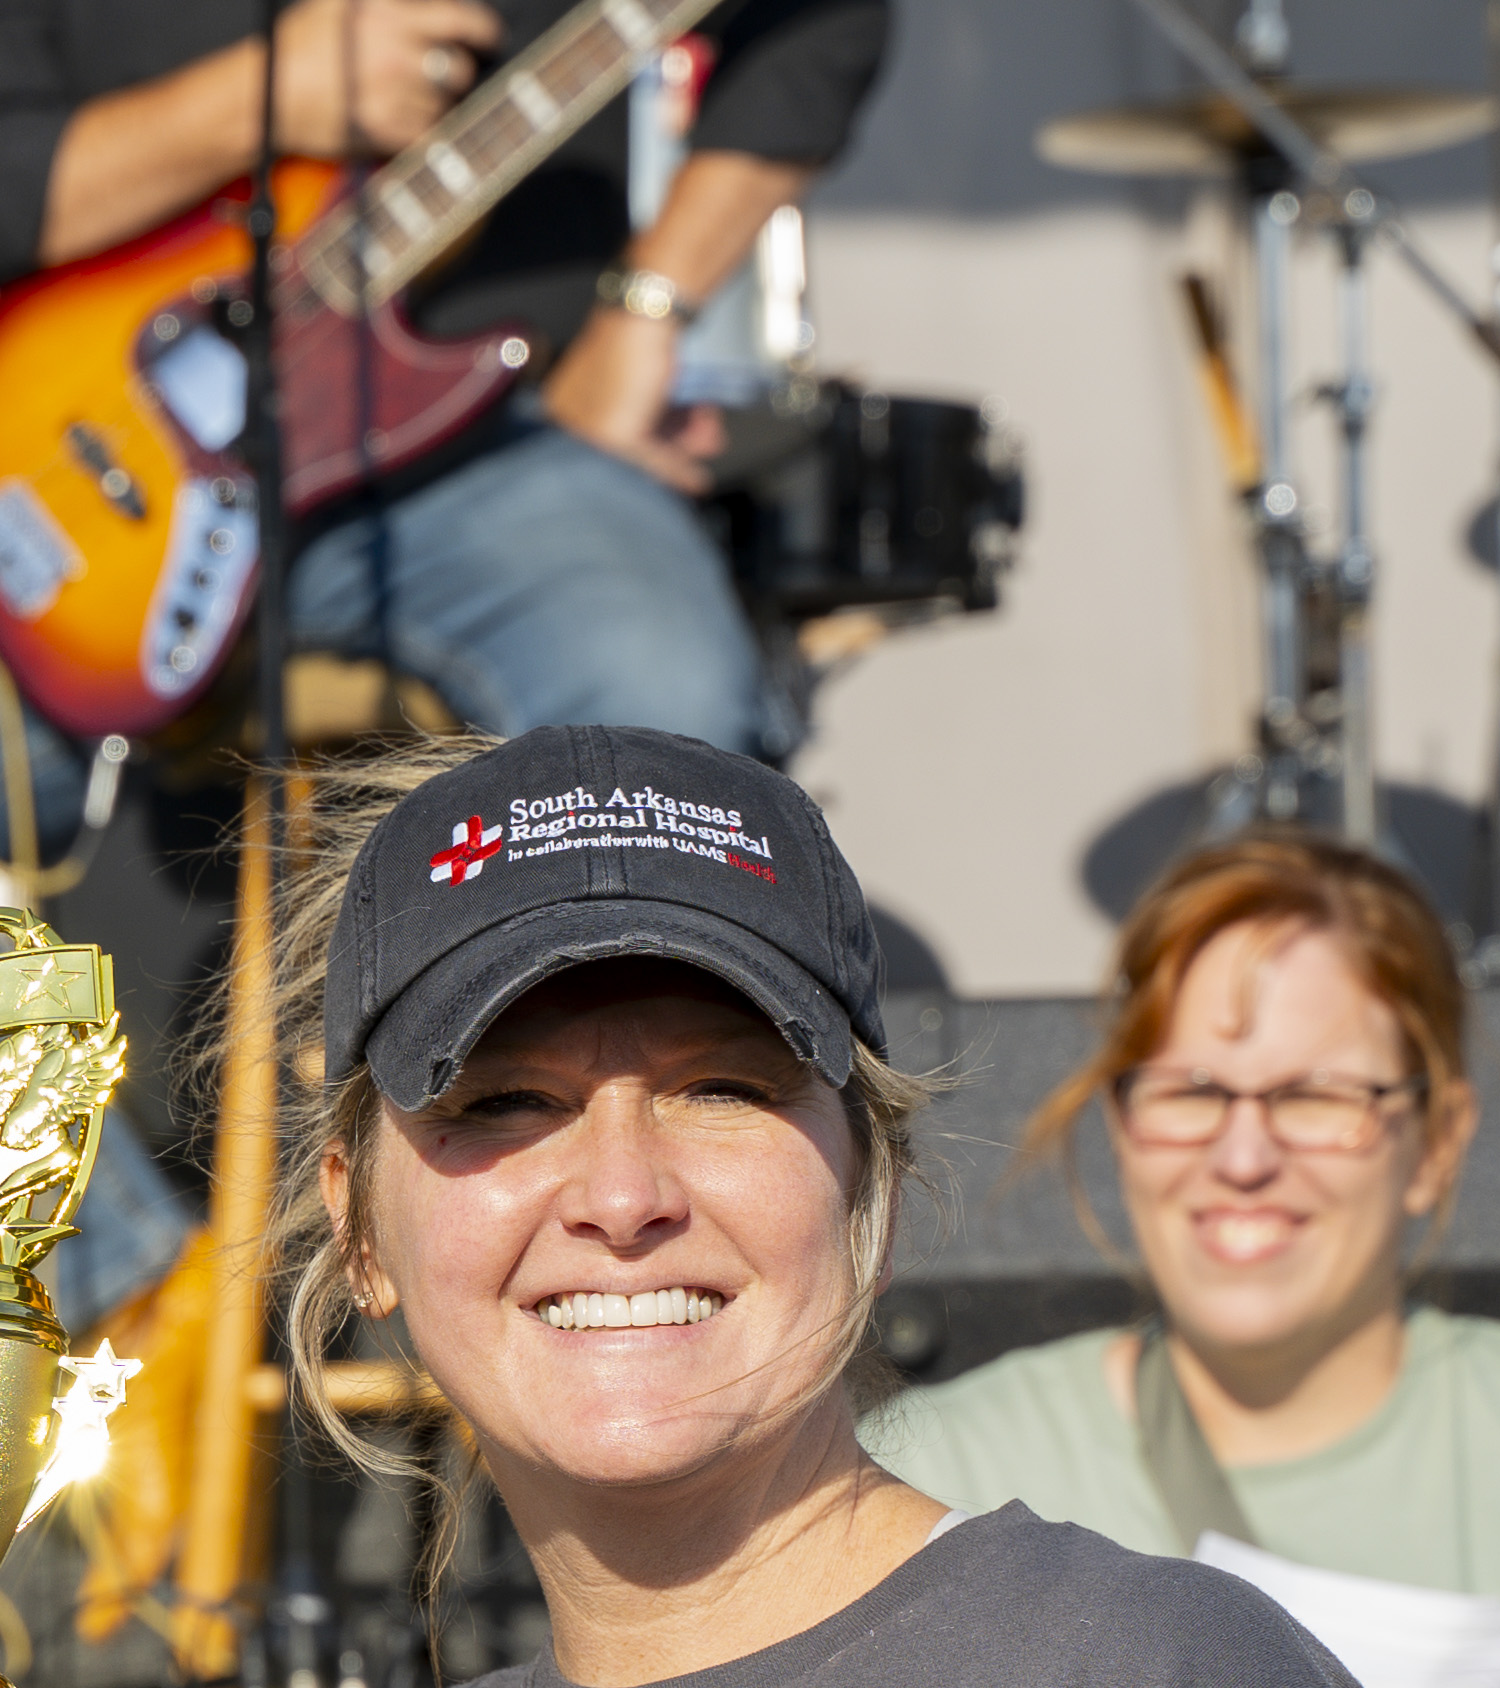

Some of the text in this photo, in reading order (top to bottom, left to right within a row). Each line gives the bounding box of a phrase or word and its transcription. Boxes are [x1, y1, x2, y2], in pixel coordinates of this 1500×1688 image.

[509, 785, 742, 828] South Arkansas
[507, 809, 773, 860] Regional Hospital
